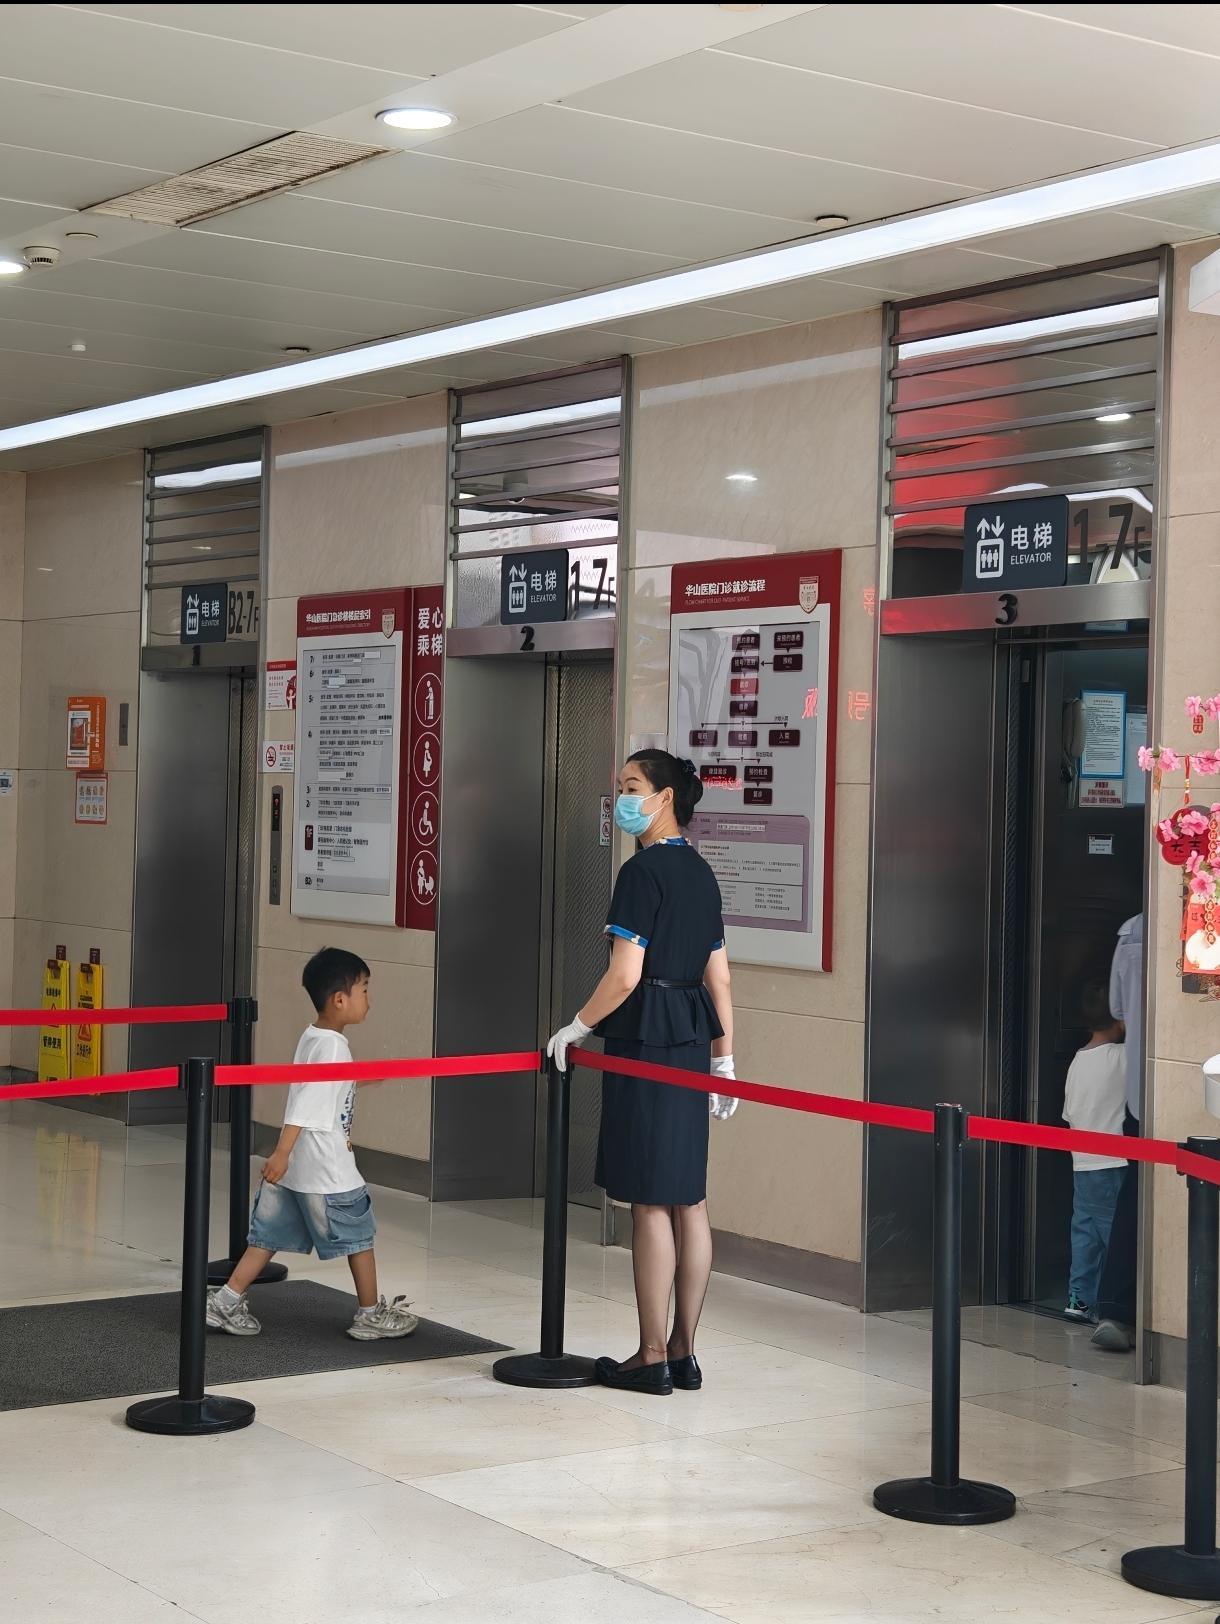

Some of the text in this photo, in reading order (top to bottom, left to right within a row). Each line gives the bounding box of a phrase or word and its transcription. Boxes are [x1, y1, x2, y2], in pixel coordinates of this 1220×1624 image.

[1011, 522, 1053, 550] 电梯
[1010, 552, 1052, 565] ELEVATOR
[530, 570, 557, 591] 电梯
[685, 579, 766, 597] 华山医院门诊就诊流程
[201, 600, 220, 618] 电梯
[530, 593, 557, 603] ELEVATOR
[995, 593, 1018, 625] 3
[228, 590, 260, 635] B2-7F
[418, 607, 444, 630] 爱心
[417, 633, 444, 657] 乘梯
[520, 625, 535, 651] 2
[192, 645, 201, 666] 1
